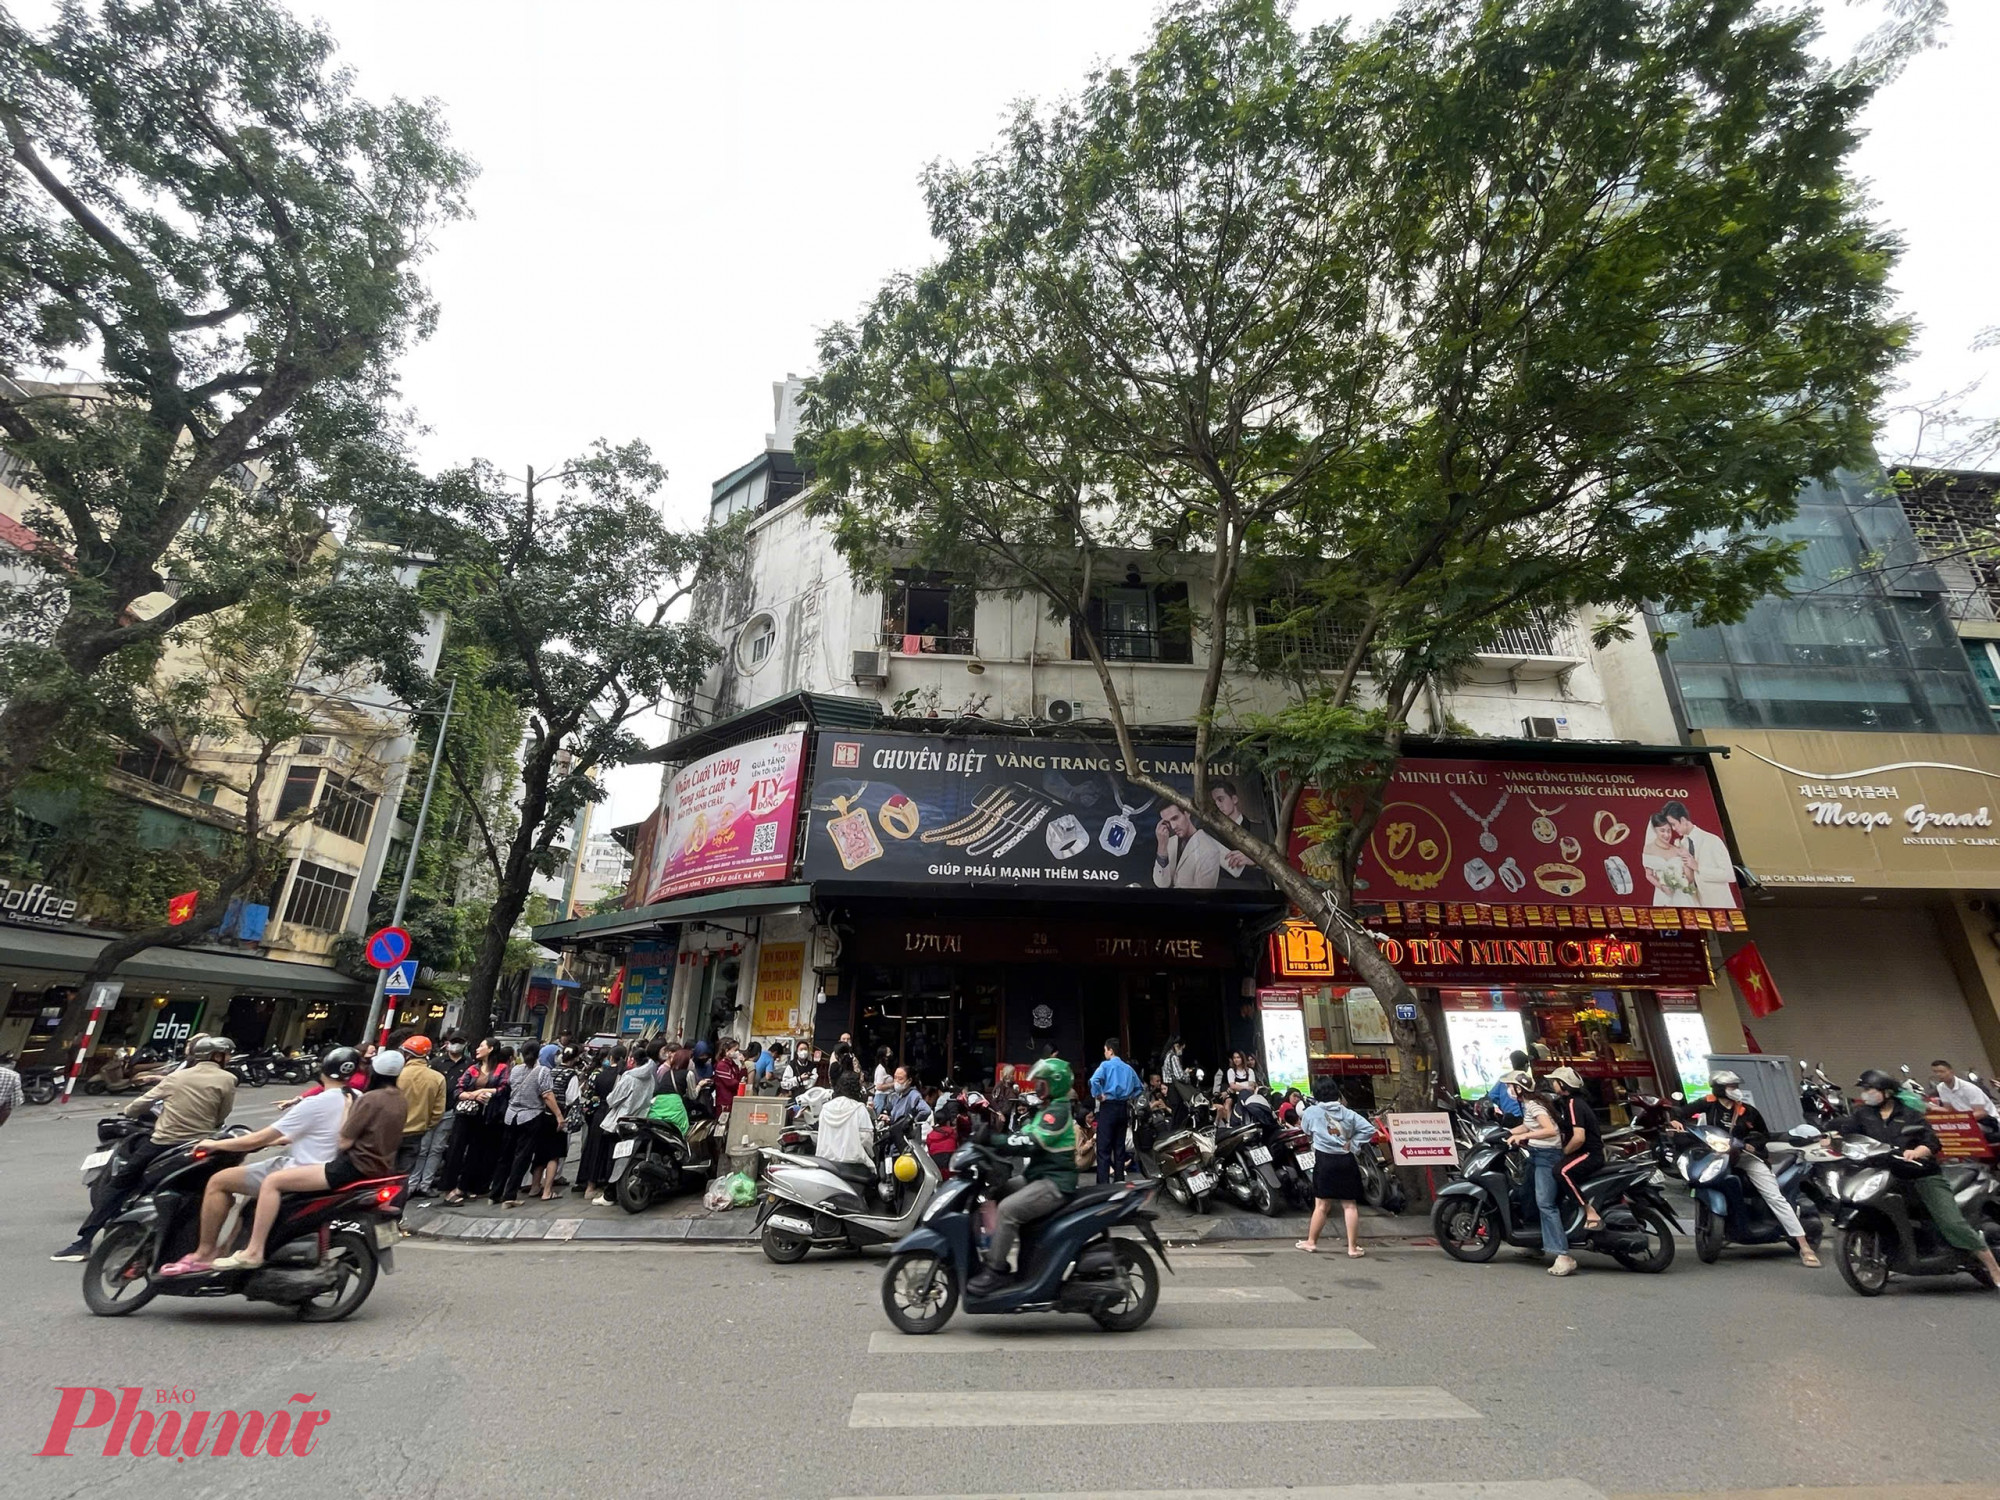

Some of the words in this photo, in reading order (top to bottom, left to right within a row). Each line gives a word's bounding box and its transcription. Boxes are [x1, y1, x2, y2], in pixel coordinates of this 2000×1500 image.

[873, 746, 942, 771] CHUYÊN
[946, 748, 987, 777] BIỆT
[995, 752, 1046, 769] VÀNG
[1050, 756, 1110, 771] TRANG
[1115, 757, 1150, 773] SC
[1155, 761, 1194, 775] NAM
[692, 764, 711, 787] Cưới
[713, 759, 740, 778] Vàng
[1399, 771, 1441, 784] MINH
[1445, 770, 1488, 785] CHÂU
[1503, 770, 1535, 782] VÀNG
[1535, 771, 1567, 783] RỒNG
[1568, 772, 1604, 783] THĂNG
[1605, 774, 1635, 784] LONG
[748, 780, 759, 811] 1
[1506, 783, 1536, 795] VÀNG
[1537, 785, 1573, 796] TRANG
[1575, 784, 1596, 797] SỨC
[1597, 783, 1625, 797] CHẤT
[1626, 787, 1664, 800] LƯỢNG
[1665, 788, 1689, 799] CAO
[1805, 802, 1893, 833] Mega
[1904, 803, 1993, 833] Grand
[1903, 837, 1957, 845] INSTITUTE
[1963, 838, 2000, 846] CLINIC
[703, 876, 717, 886] 139
[927, 863, 960, 876] GIÚP
[964, 864, 996, 877] PHÁI
[1000, 867, 1040, 881] MẠNH
[1044, 866, 1079, 880] THÊM
[1082, 869, 1120, 881] SANG
[1409, 931, 1464, 965] TÍN
[1471, 939, 1557, 966] MINH
[1557, 933, 1642, 967] CHÂU
[153, 1013, 191, 1040] aha
